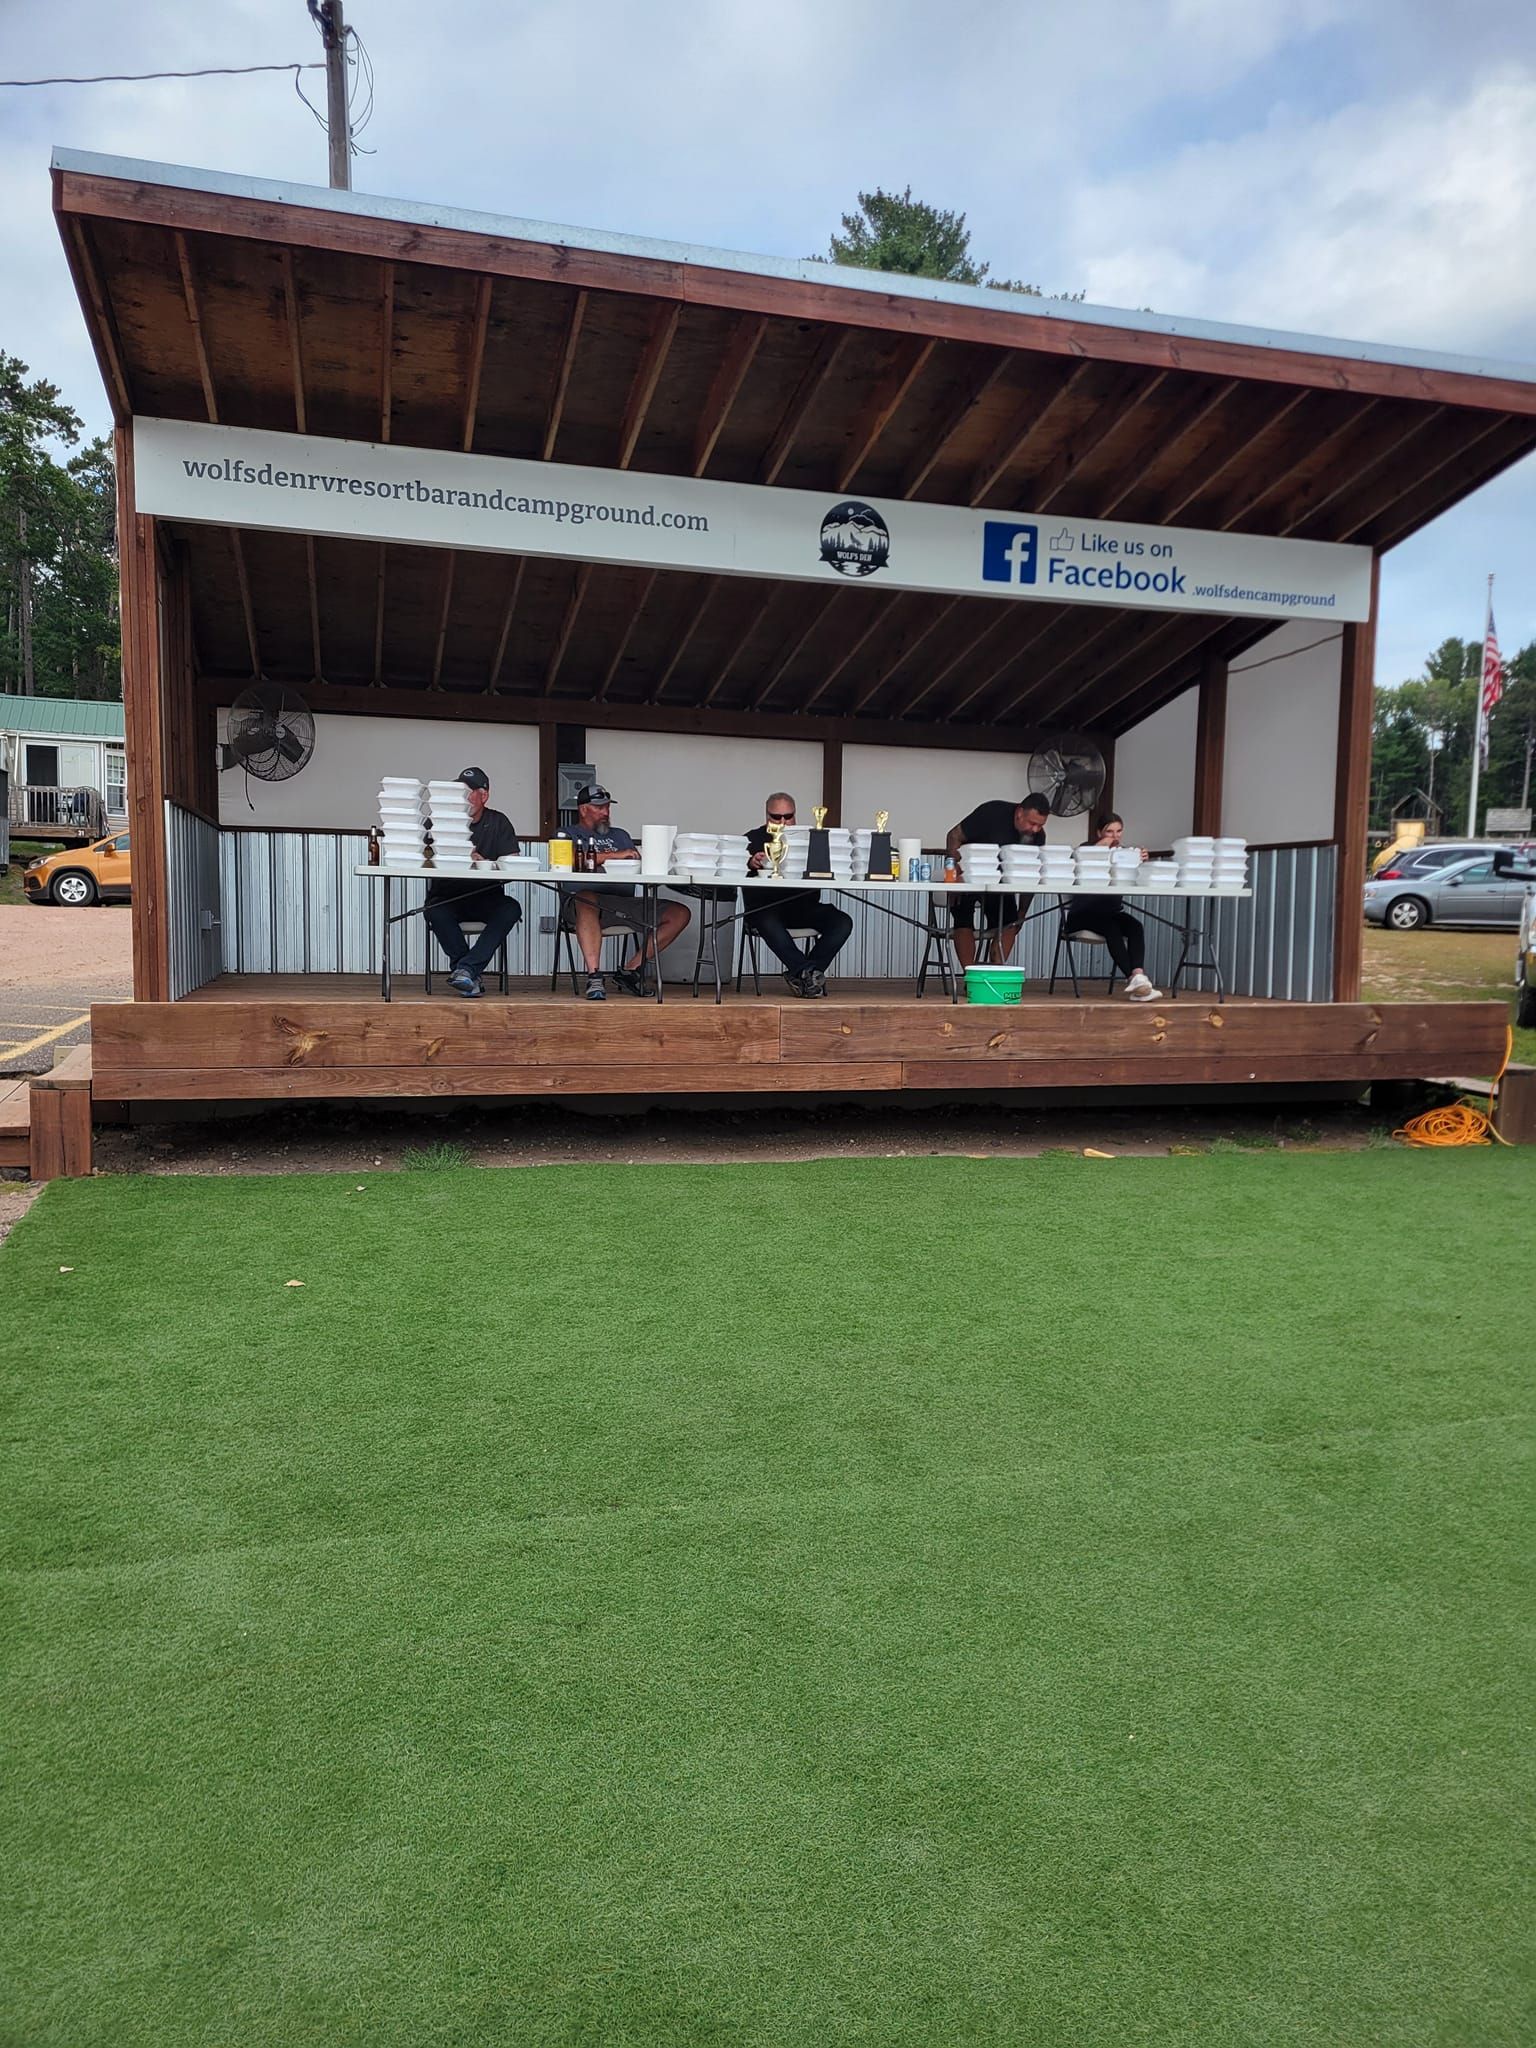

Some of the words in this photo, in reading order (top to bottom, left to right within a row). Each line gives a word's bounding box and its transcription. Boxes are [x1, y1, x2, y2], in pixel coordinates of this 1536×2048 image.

[183, 459, 709, 531] wolfsdenrvresortbarandcampground.com
[1081, 533, 1119, 554] Like
[1124, 542, 1145, 556] us
[1150, 544, 1173, 558] on
[1049, 558, 1186, 594] Facebook
